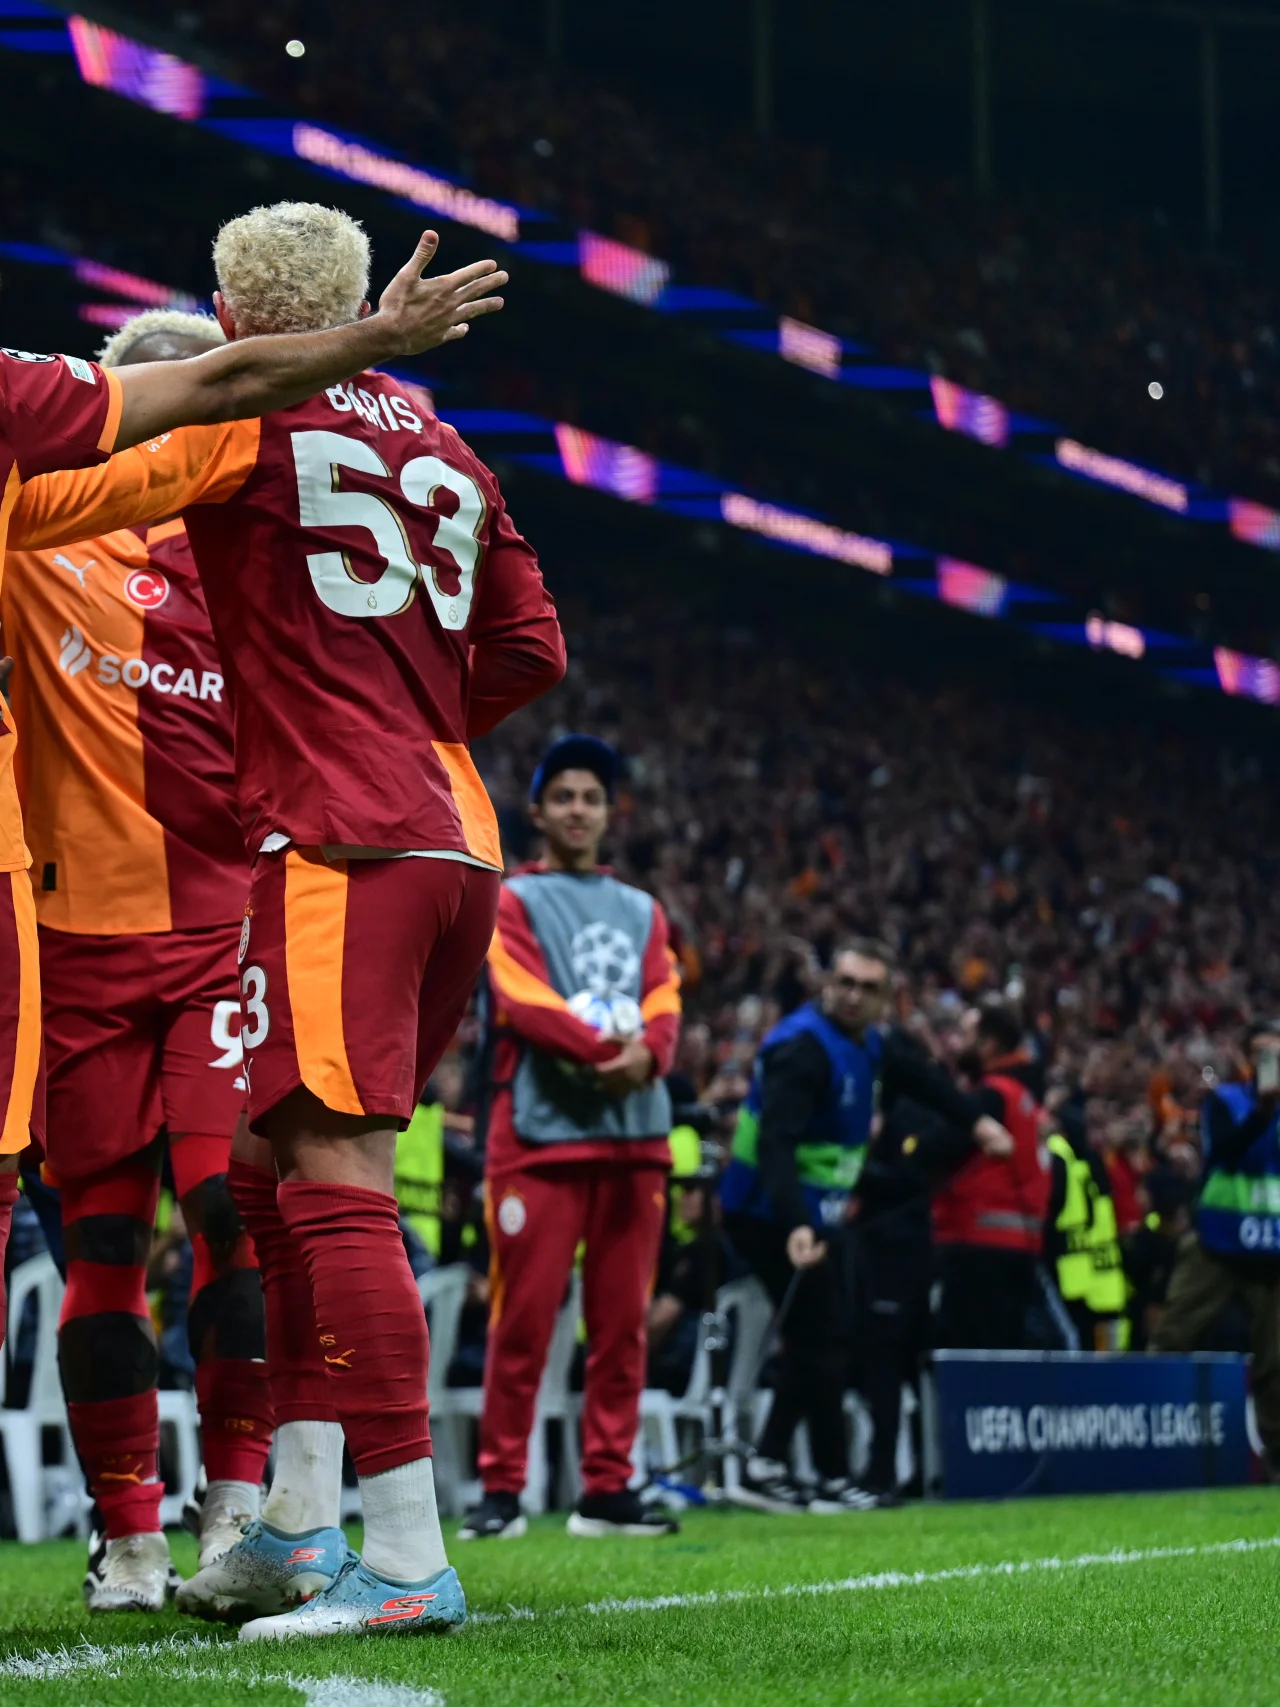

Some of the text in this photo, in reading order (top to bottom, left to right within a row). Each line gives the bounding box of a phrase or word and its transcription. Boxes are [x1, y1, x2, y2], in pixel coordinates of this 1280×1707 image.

[325, 382, 422, 433] BARIŞ
[290, 430, 487, 631] 53
[96, 654, 225, 702] SOCAR
[966, 1404, 1027, 1454] UEFA
[1027, 1402, 1148, 1452] CHAMPIONS
